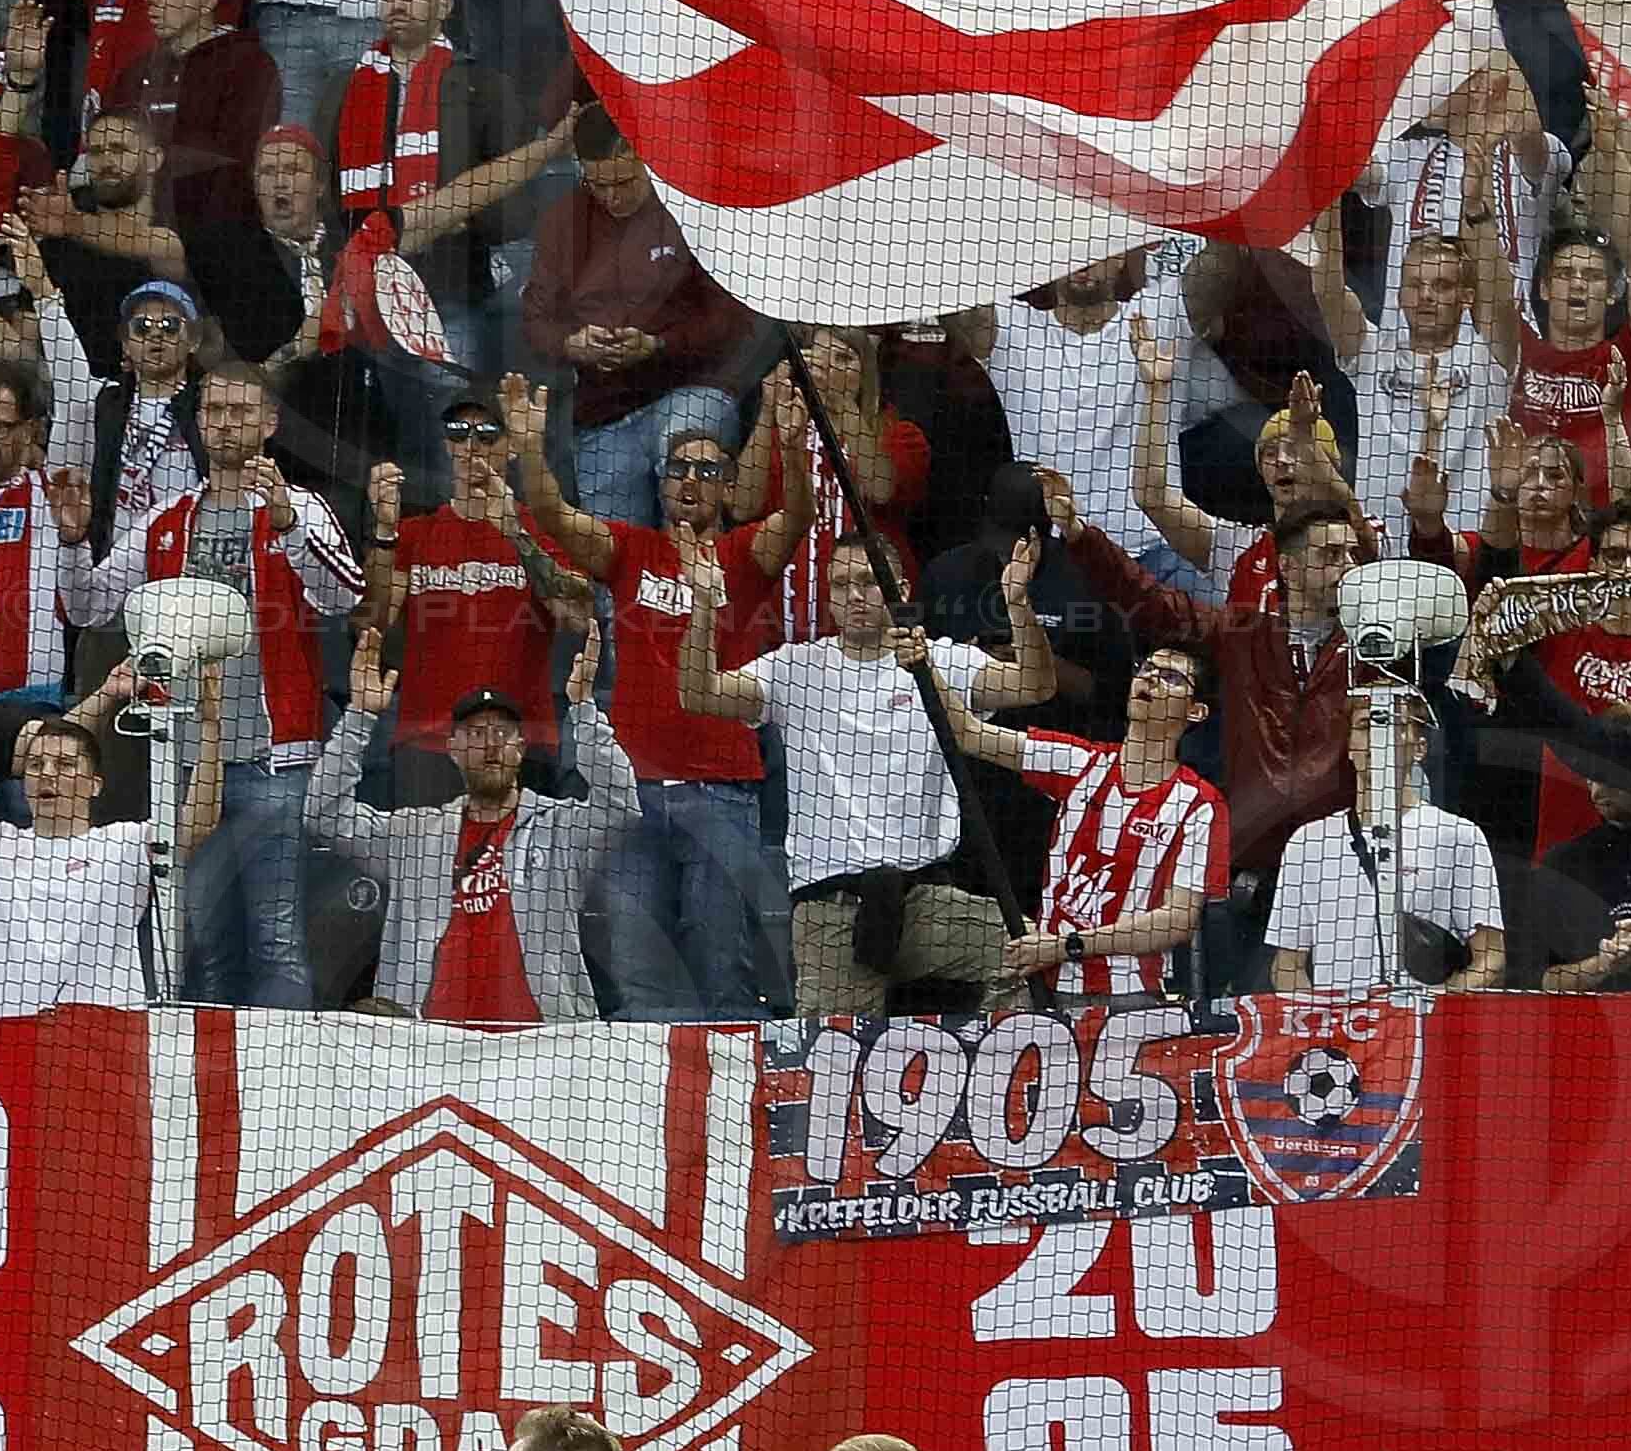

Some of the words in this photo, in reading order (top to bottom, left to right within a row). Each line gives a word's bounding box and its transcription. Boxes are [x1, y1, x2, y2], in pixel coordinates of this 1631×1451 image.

[1279, 1007, 1381, 1042] KFC
[805, 1007, 1191, 1183] 1905
[785, 1190, 961, 1234] KREFELDER
[968, 1178, 1125, 1220] FUSSBALL
[1134, 1171, 1216, 1208] CLUB
[189, 1148, 703, 1443] ROTES
